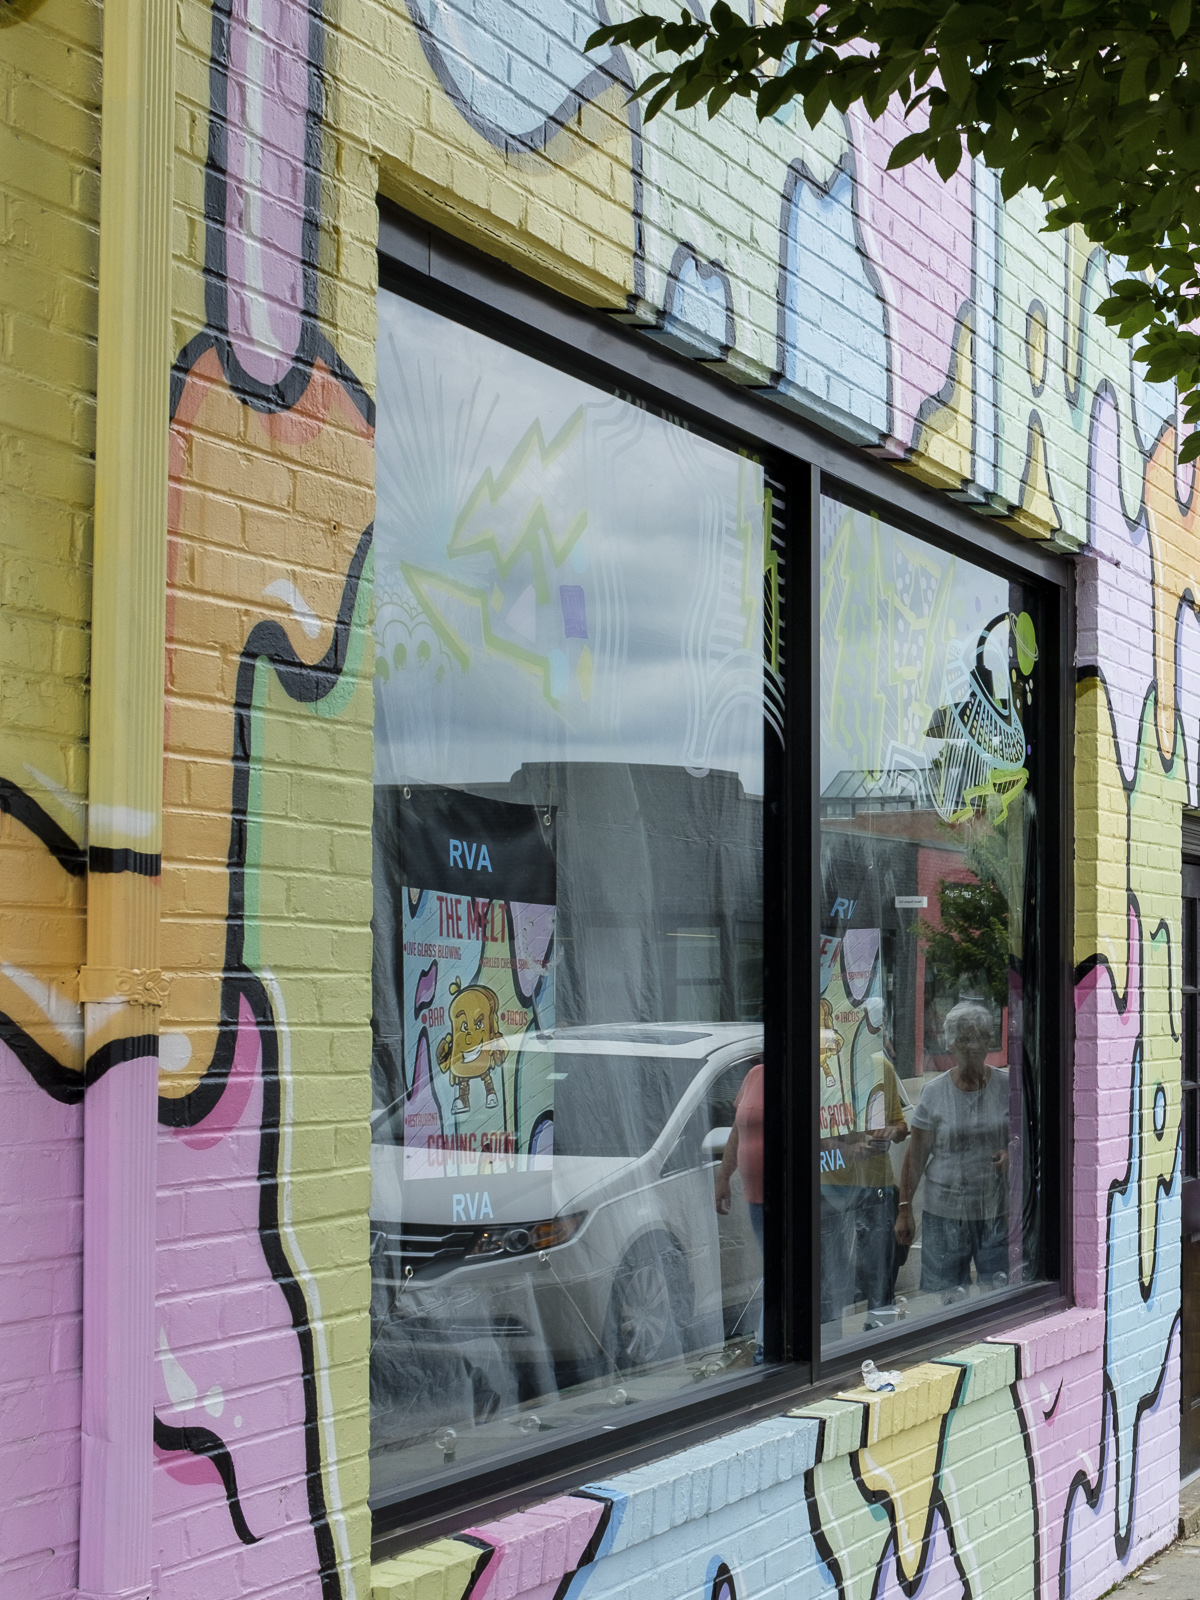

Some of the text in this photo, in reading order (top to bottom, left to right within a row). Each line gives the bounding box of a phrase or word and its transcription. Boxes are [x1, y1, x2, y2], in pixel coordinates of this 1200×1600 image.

[449, 838, 493, 873] RVA
[436, 895, 508, 943] THE MELT
[406, 941, 462, 960] LIVE GLASS BLOWING
[427, 1007, 445, 1028] BAR
[507, 1009, 528, 1026] TACOS
[840, 1011, 860, 1023] TACOS
[408, 1112, 438, 1128] RESTAURANT
[828, 1103, 854, 1127] SOON
[427, 1130, 514, 1167] COMING SOON
[452, 1191, 494, 1222] RVA
